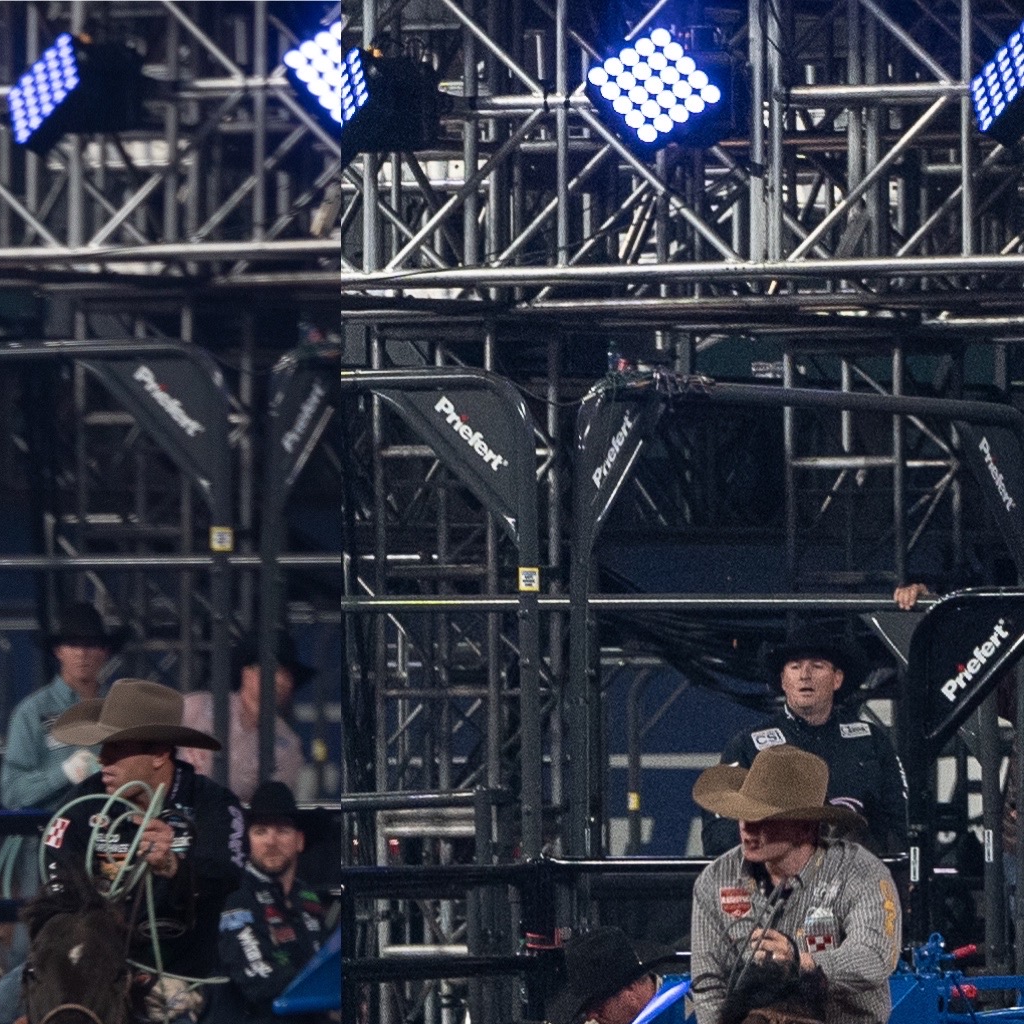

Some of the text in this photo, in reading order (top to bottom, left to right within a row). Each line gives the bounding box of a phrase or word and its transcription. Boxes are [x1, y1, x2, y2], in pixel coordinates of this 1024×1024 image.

[434, 396, 508, 471] Priefert
[592, 409, 632, 489] Priefert
[979, 436, 1016, 511] Priefert
[941, 618, 1009, 702] Priefert
